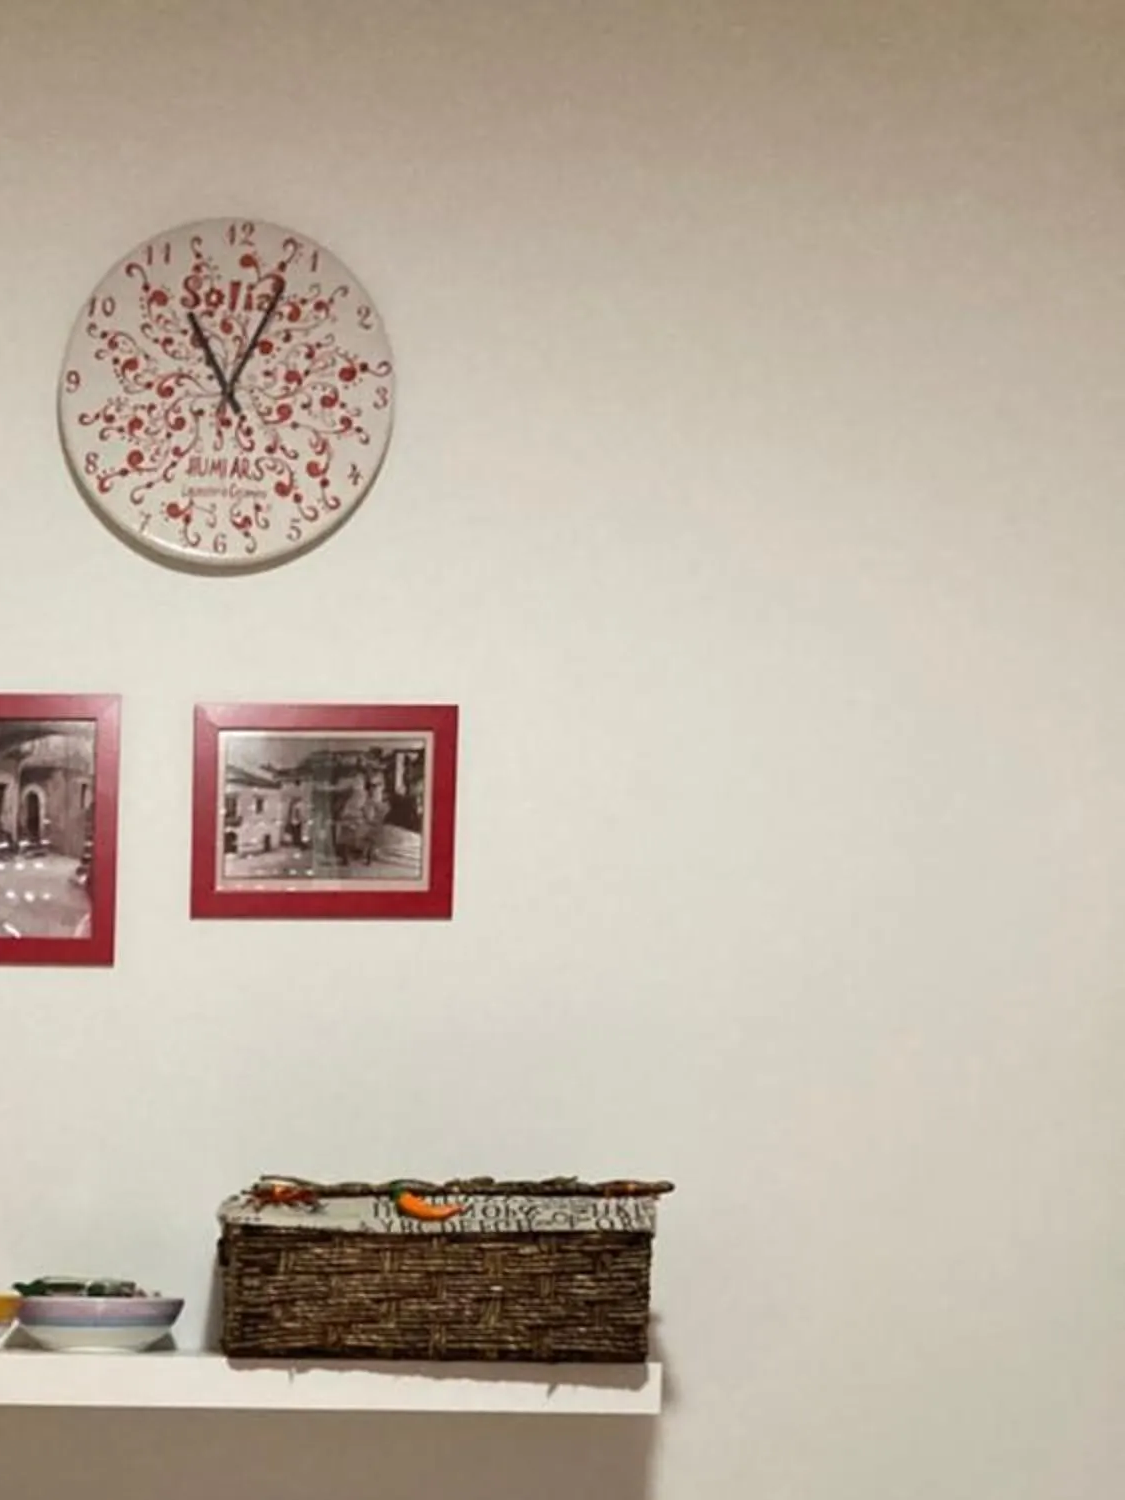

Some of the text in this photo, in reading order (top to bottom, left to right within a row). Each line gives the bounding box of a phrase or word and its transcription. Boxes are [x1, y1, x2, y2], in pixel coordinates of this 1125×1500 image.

[228, 221, 255, 247] 12
[145, 242, 172, 266] 11
[309, 250, 319, 272] 1
[86, 296, 115, 318] 10
[356, 304, 373, 330] 2
[65, 369, 81, 394] 9
[373, 386, 389, 410] 3
[84, 451, 99, 475] 8
[286, 517, 303, 542] 5
[213, 532, 228, 554] 6
